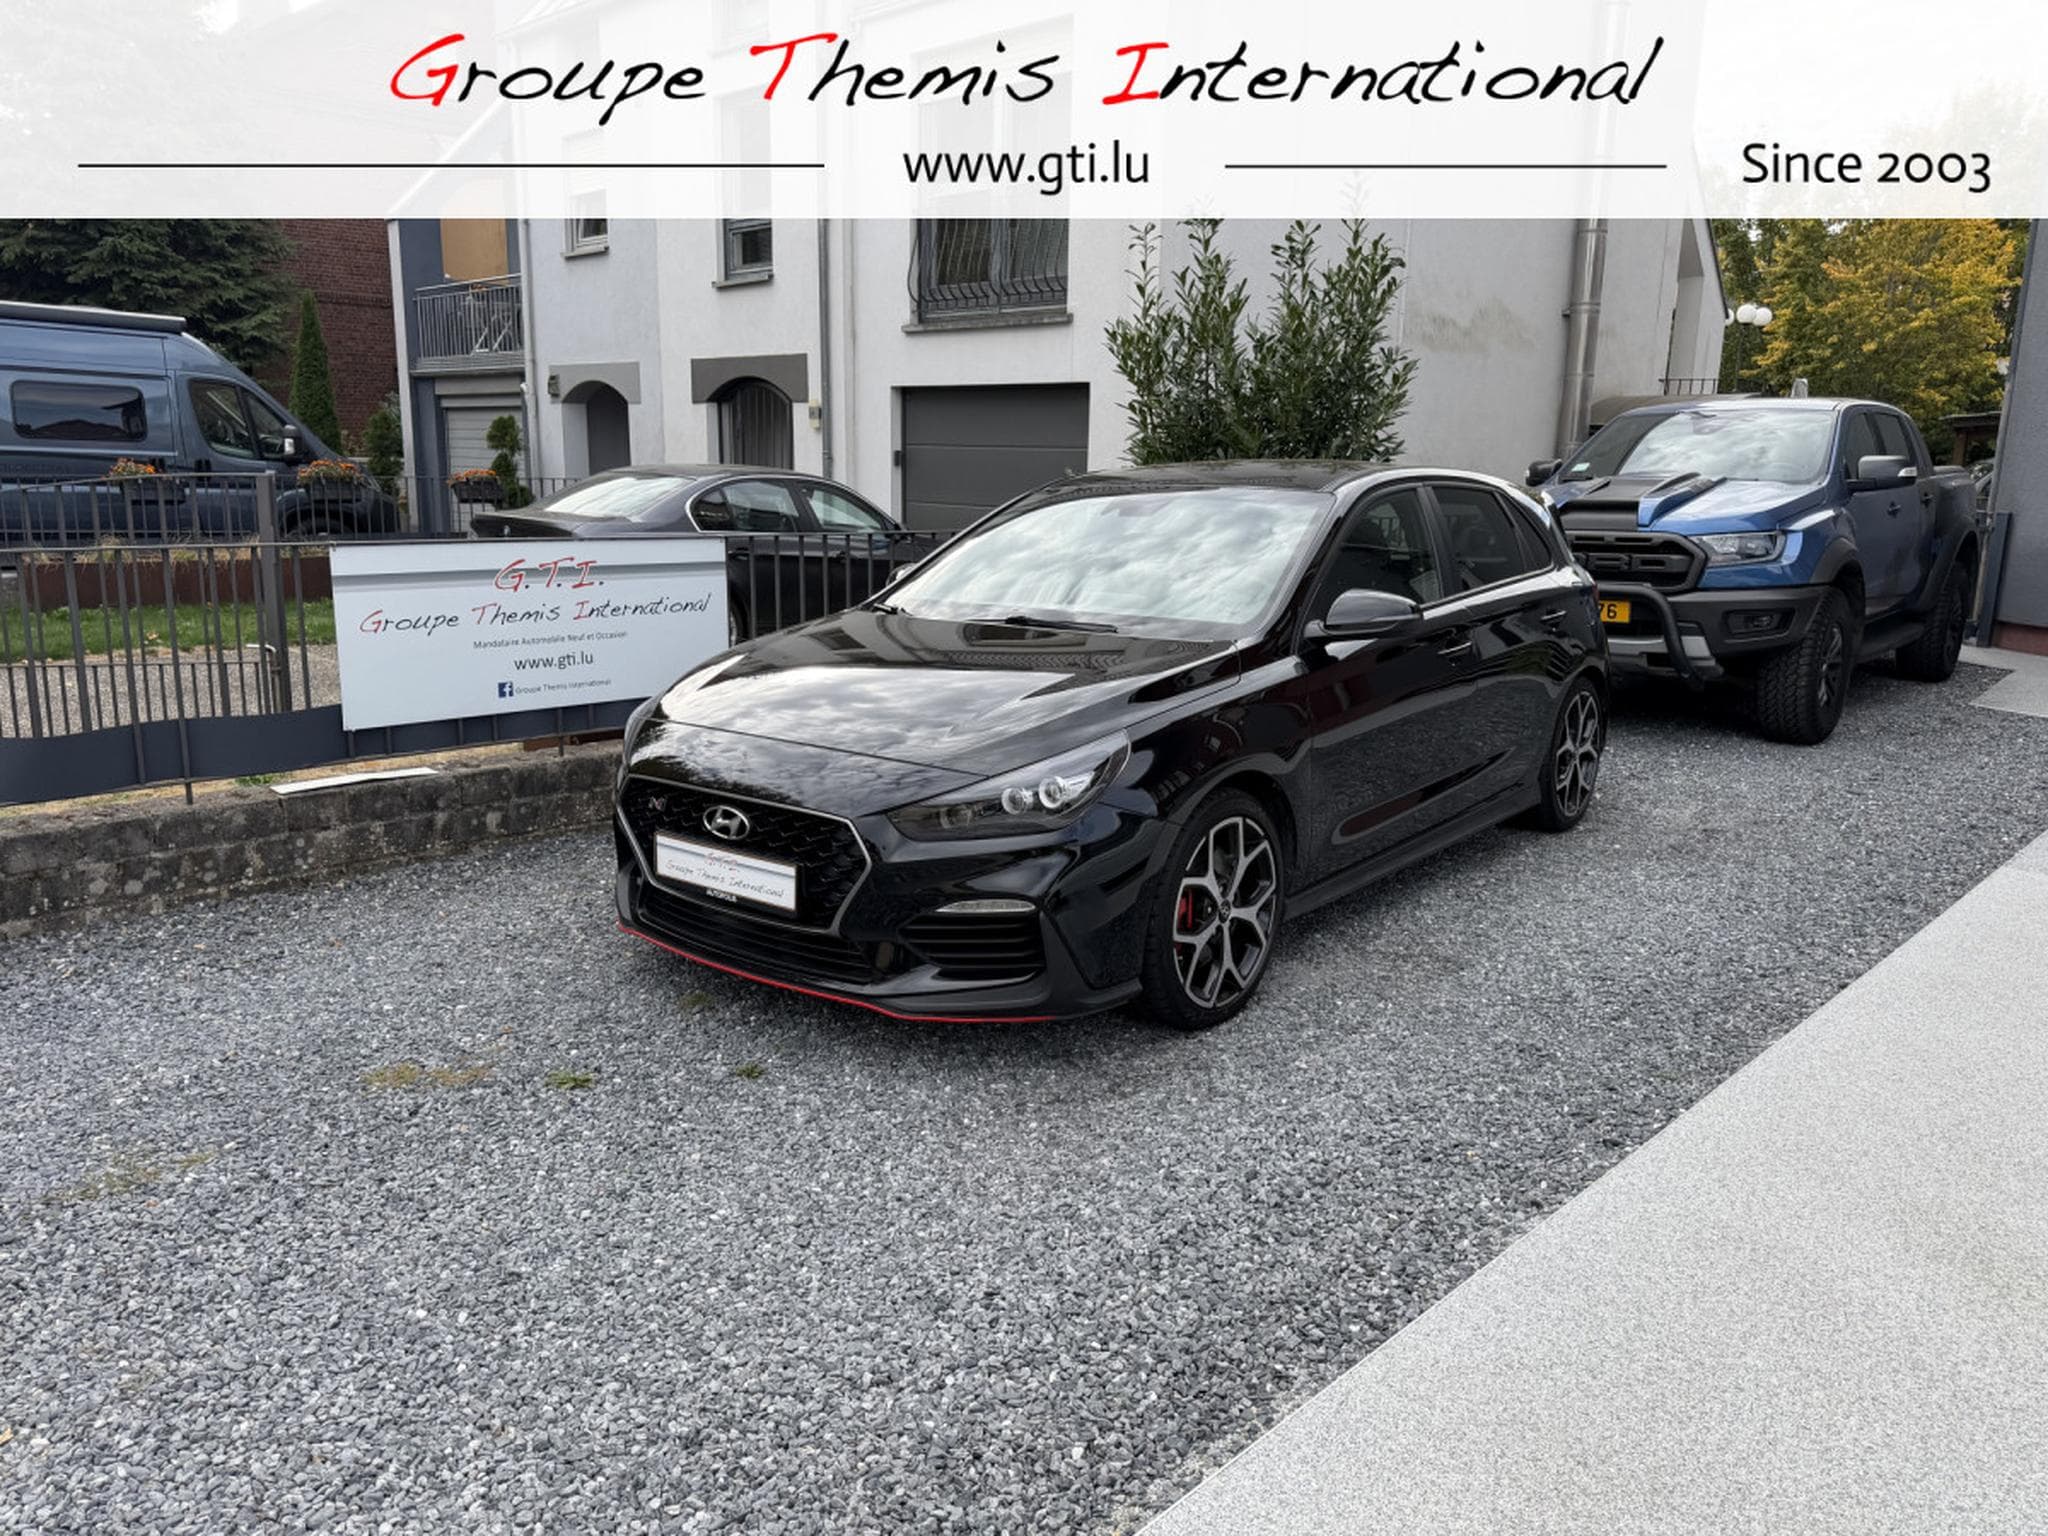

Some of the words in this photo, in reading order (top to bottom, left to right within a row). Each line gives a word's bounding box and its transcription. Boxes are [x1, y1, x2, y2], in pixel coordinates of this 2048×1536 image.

[495, 557, 604, 592] G.T.I.
[359, 609, 460, 637] Groupe
[471, 602, 561, 625] Themis
[573, 592, 712, 621] International
[473, 638, 519, 649] Mandataire
[587, 633, 595, 641] et
[595, 631, 628, 641] Occasion
[514, 650, 594, 671] www.gti.lu
[515, 684, 541, 696] Groupe
[568, 678, 612, 690] International
